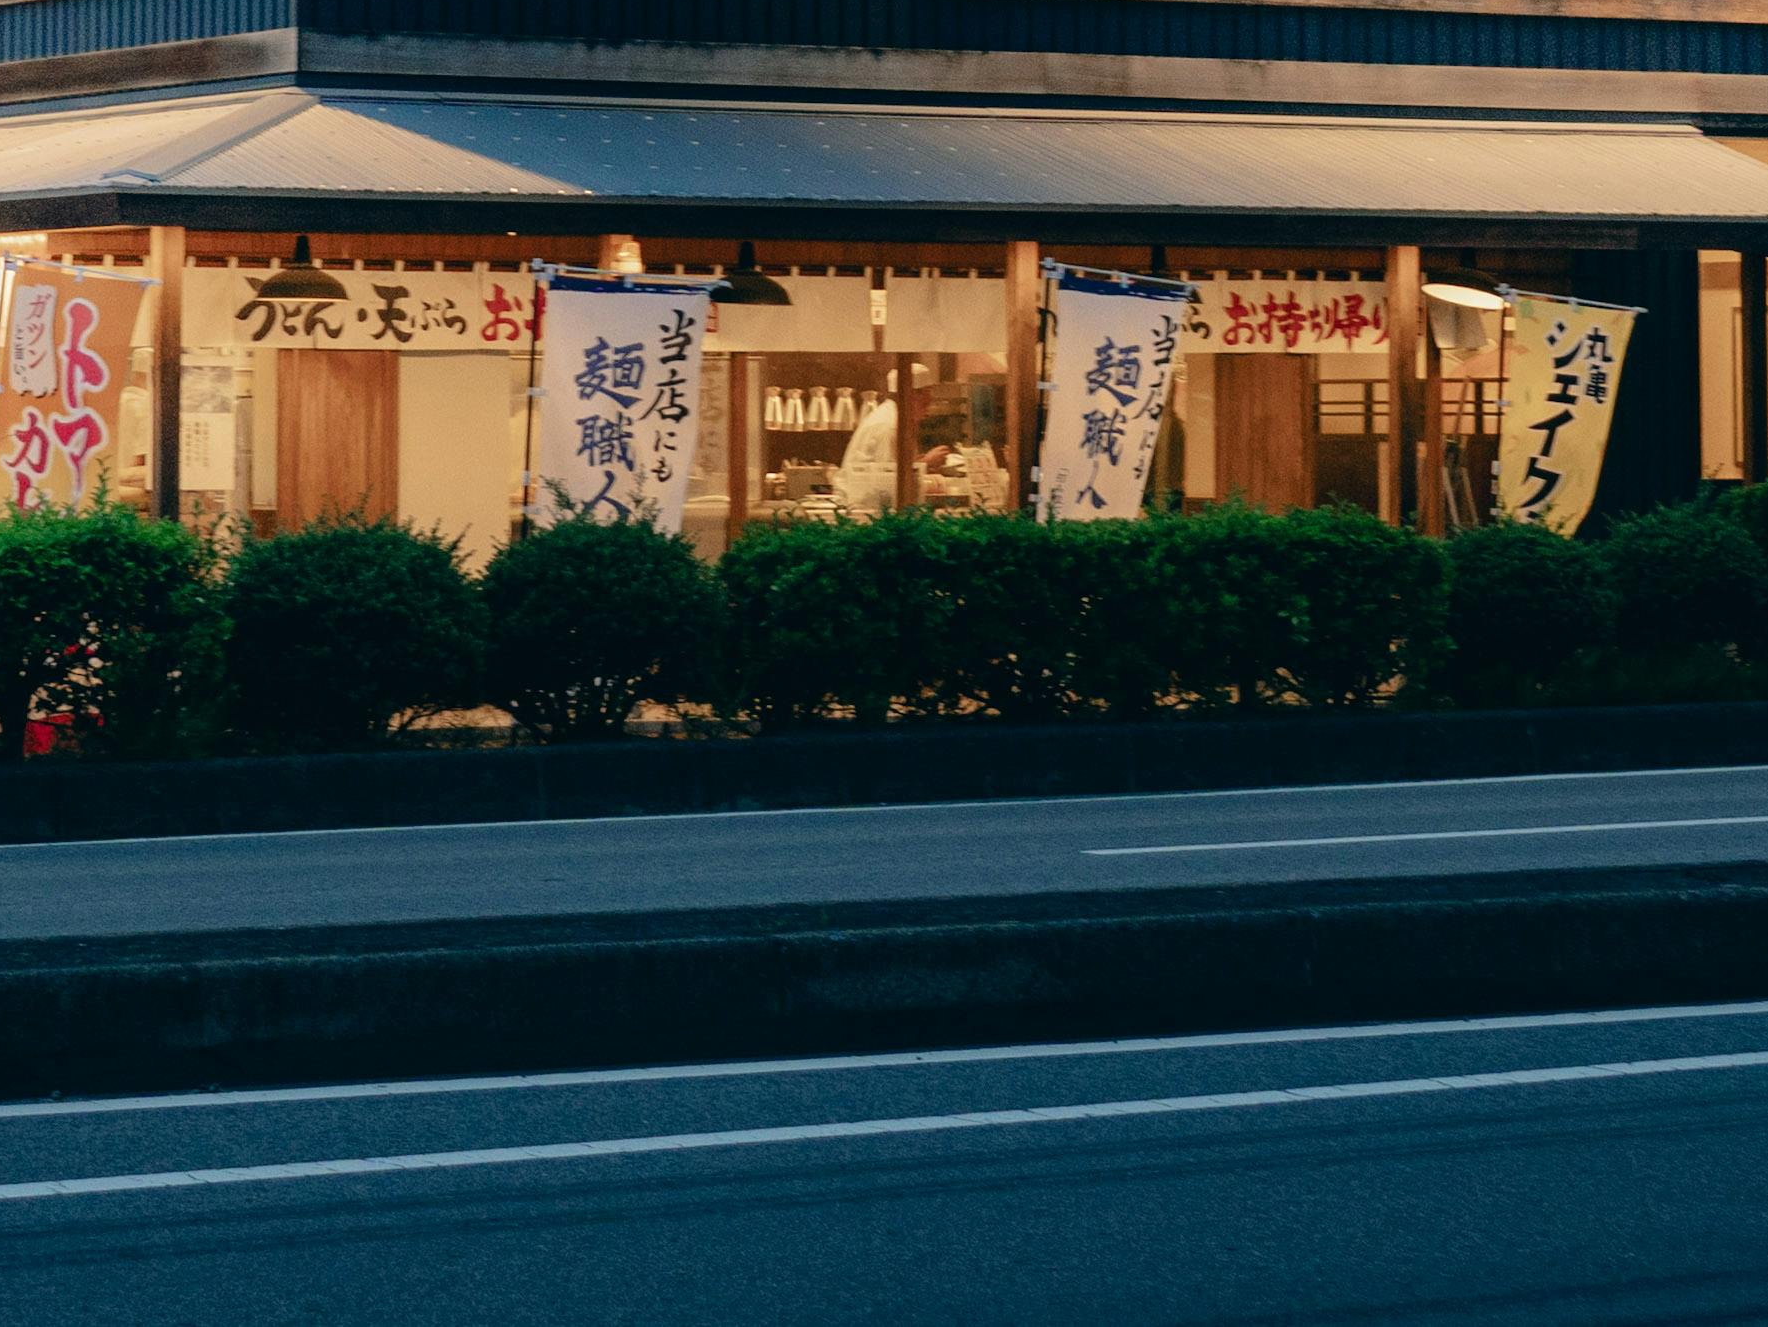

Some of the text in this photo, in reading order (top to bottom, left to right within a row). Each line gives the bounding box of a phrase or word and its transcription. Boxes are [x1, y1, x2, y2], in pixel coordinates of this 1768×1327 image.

[575, 335, 646, 521] 麺職人
[640, 308, 695, 483] 当店にも
[1519, 321, 1582, 520] シェイク
[1585, 326, 1614, 404] 丸亀
